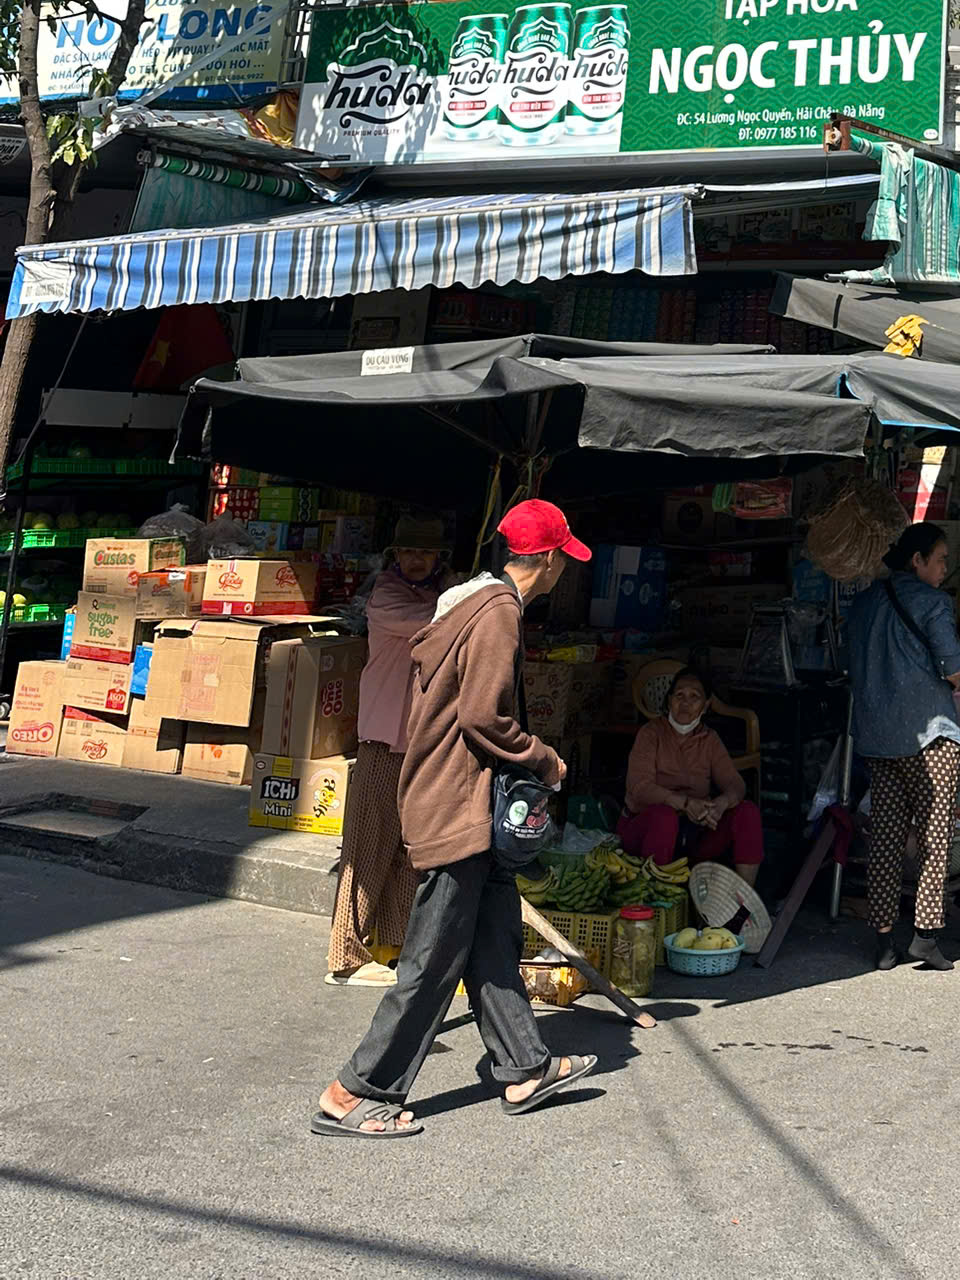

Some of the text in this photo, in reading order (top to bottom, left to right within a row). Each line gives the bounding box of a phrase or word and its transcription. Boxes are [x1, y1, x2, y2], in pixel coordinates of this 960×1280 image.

[155, 5, 273, 41] LONG
[249, 39, 270, 53] MẬT
[503, 53, 570, 84] huda
[648, 20, 928, 104] NGỌC THỦY
[323, 65, 432, 110] huda
[677, 112, 692, 126] ĐC:
[693, 112, 706, 125] 54
[706, 111, 736, 127] Lương
[737, 109, 762, 126] Ngọc
[762, 107, 795, 124] Quyến,
[796, 107, 813, 121] Hải
[843, 105, 857, 118] Đà
[858, 103, 886, 120] Nẵng
[738, 126, 817, 141] ĐT: 0977 185 116
[93, 549, 137, 566] Custas
[88, 611, 119, 627] sugar
[89, 622, 112, 639] free
[11, 721, 55, 743] OREO
[264, 801, 292, 817] Mini
